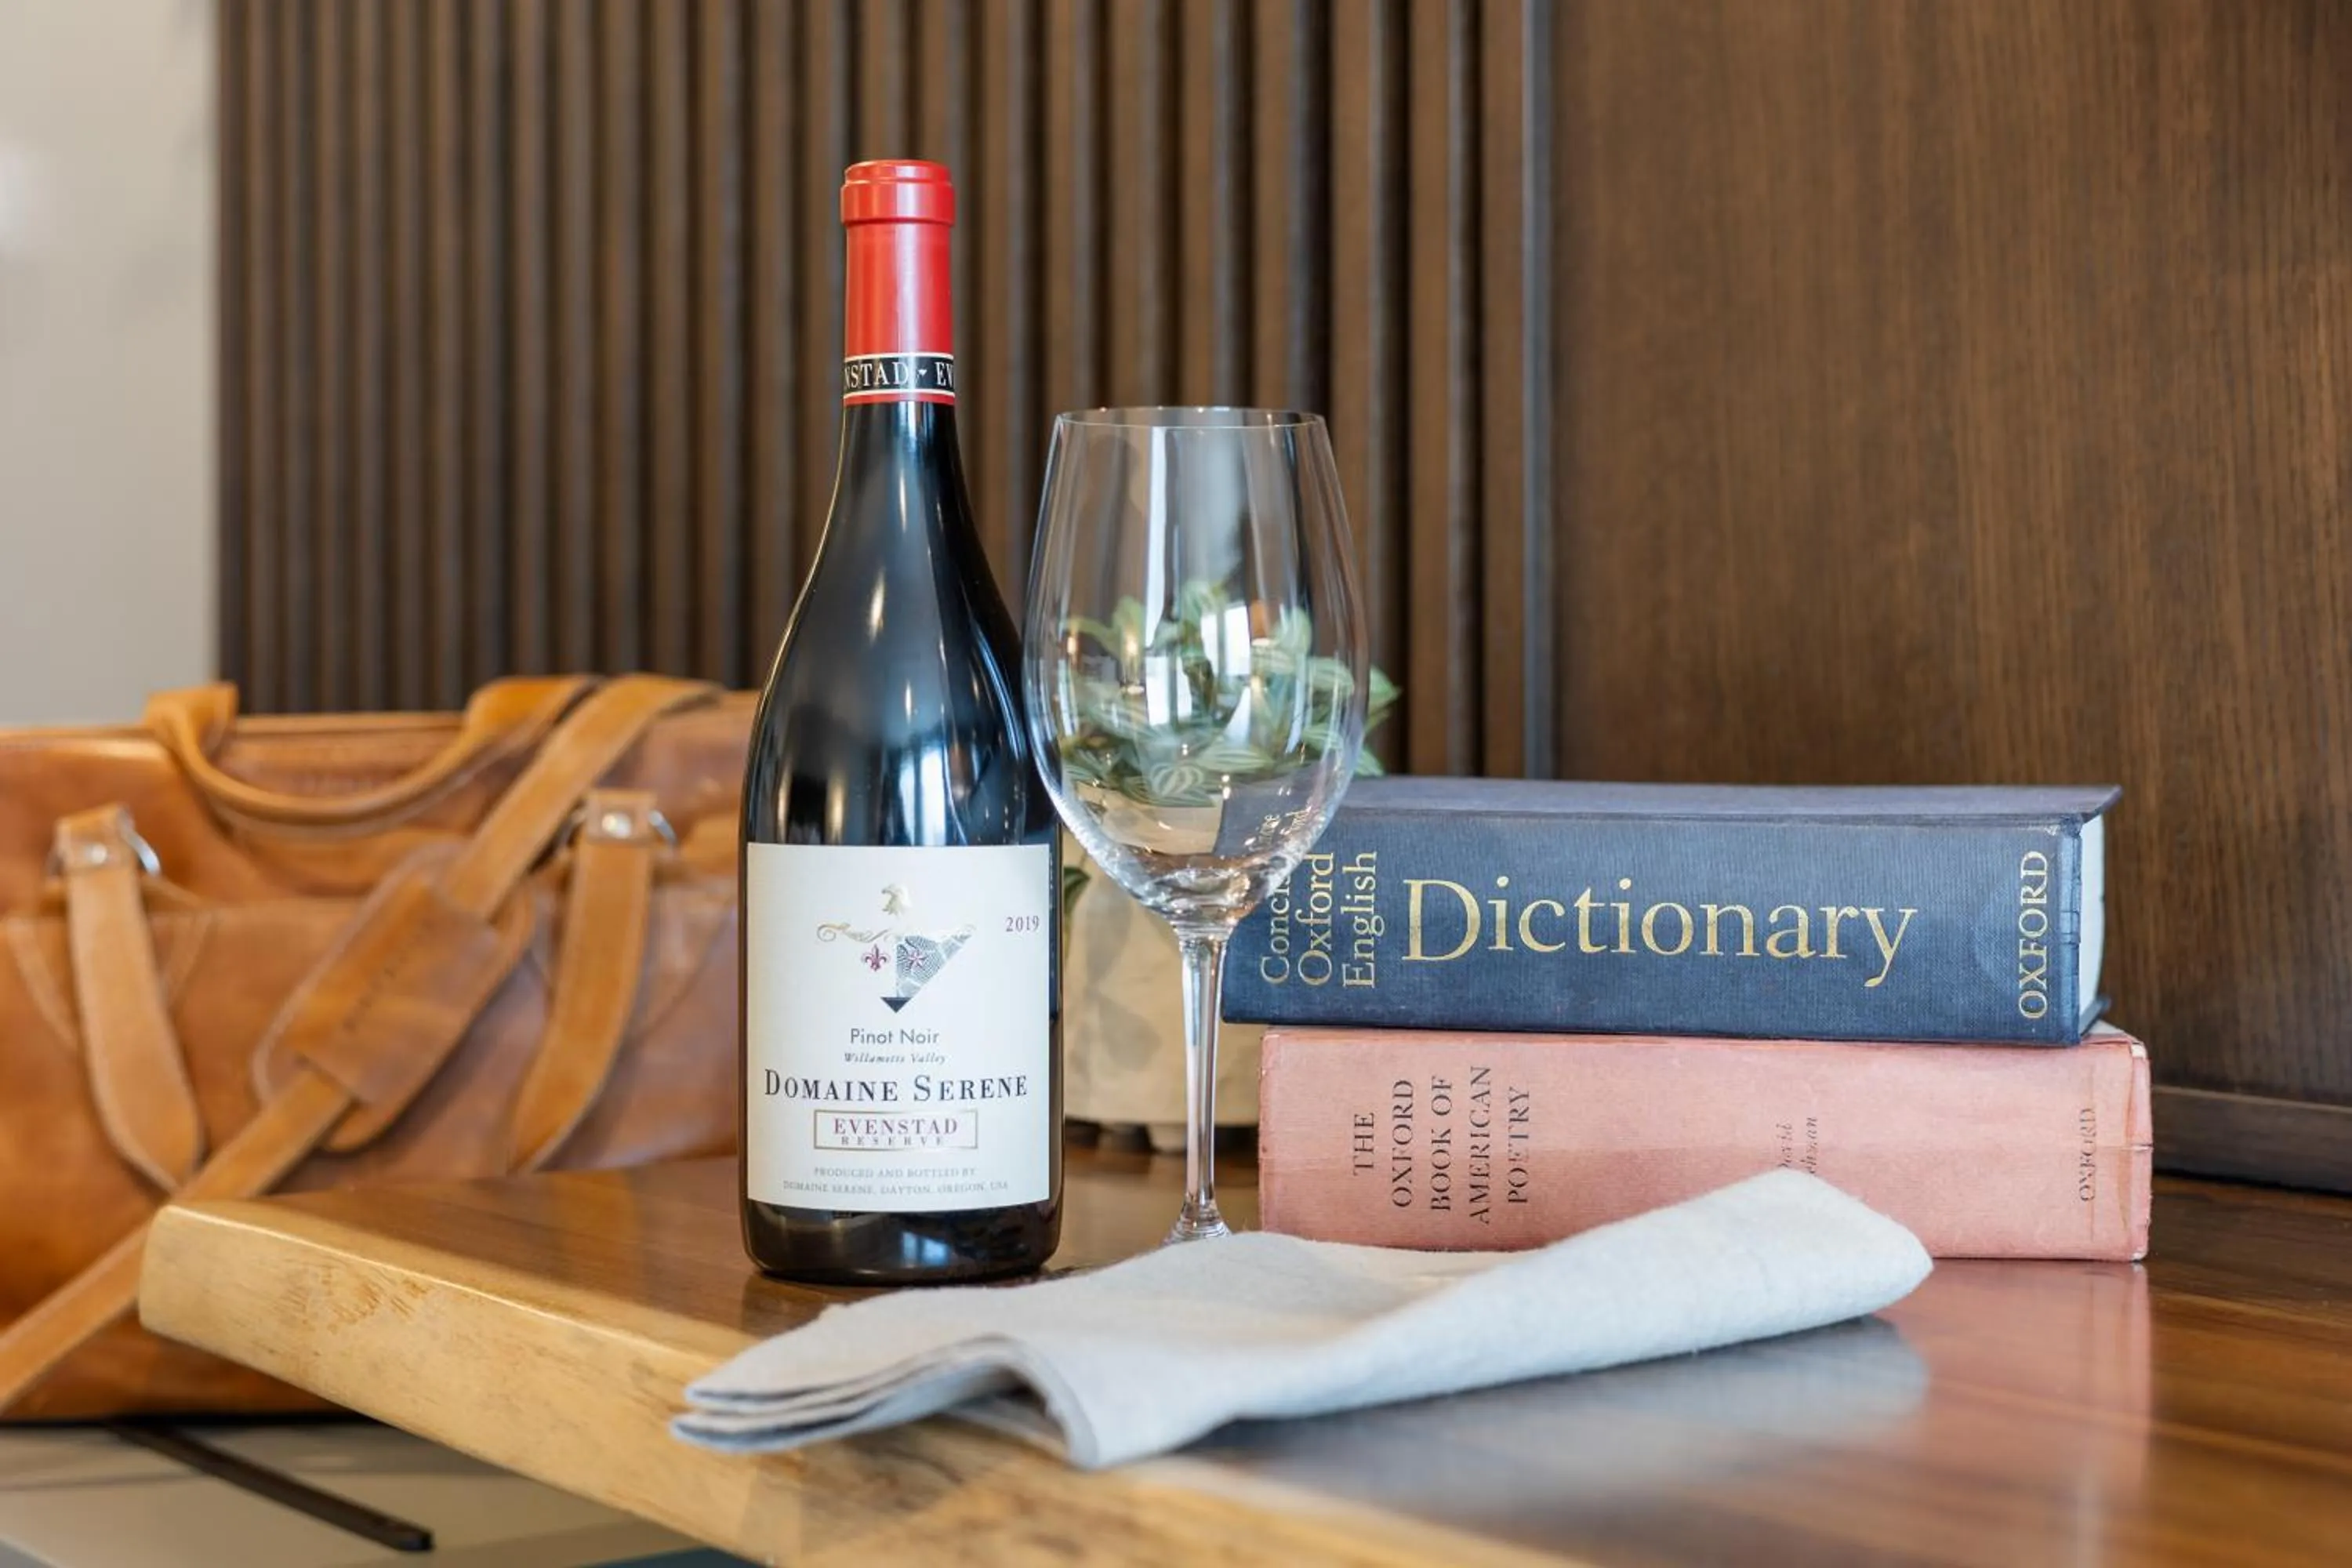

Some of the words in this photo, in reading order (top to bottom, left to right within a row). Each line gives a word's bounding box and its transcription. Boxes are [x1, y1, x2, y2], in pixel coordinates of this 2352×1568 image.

[1005, 915, 1040, 933] 2019
[1296, 851, 1334, 986] Oxford
[1340, 851, 1385, 989] English
[1402, 876, 1918, 987] Dictionary
[2018, 851, 2049, 1019] OXFORD
[850, 1028, 893, 1044] Pinot
[899, 1028, 940, 1044] Noir
[910, 1052, 946, 1065] Valley
[764, 1069, 898, 1102] DOMAINE
[913, 1074, 1029, 1102] SERENE
[833, 1117, 959, 1135] EVENSTAD
[1430, 1075, 1453, 1116] OF
[840, 1136, 944, 1147] RESERVE
[1352, 1112, 1375, 1177] THE
[1392, 1079, 1414, 1208] OXFORD
[1430, 1127, 1452, 1211] BOOK
[1468, 1065, 1492, 1225] AMERICAN
[1507, 1086, 1530, 1204] POETRY
[2078, 1108, 2097, 1202] OXFORD
